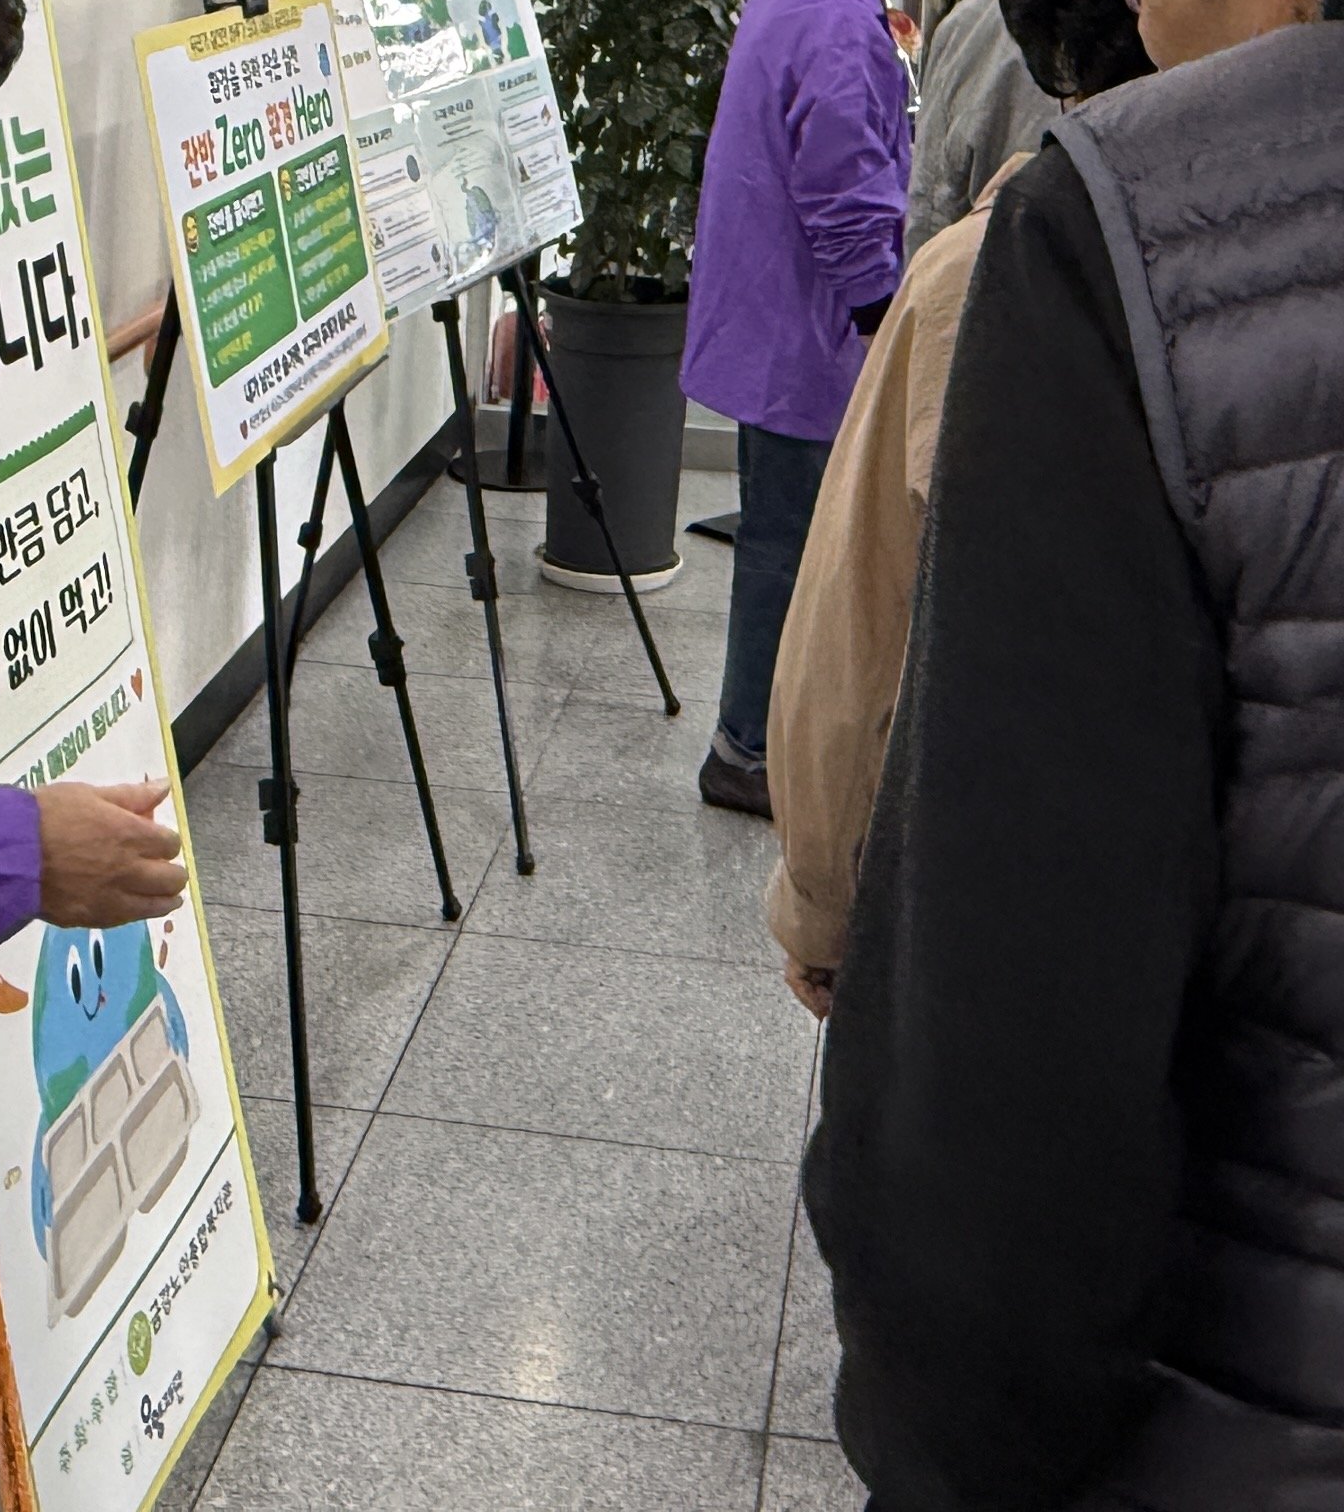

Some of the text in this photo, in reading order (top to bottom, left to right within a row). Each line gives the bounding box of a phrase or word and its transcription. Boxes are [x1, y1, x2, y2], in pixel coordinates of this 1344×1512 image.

[208, 61, 241, 104] 환경을
[241, 55, 263, 89] 위한
[262, 47, 282, 83] 작은
[181, 129, 218, 189] 잔반
[215, 114, 266, 176] Zero
[265, 96, 296, 150] 환경
[292, 84, 334, 141] Hero
[46, 467, 100, 545] 담고,
[3, 600, 57, 691] 없이
[59, 551, 114, 634] 먹고!
